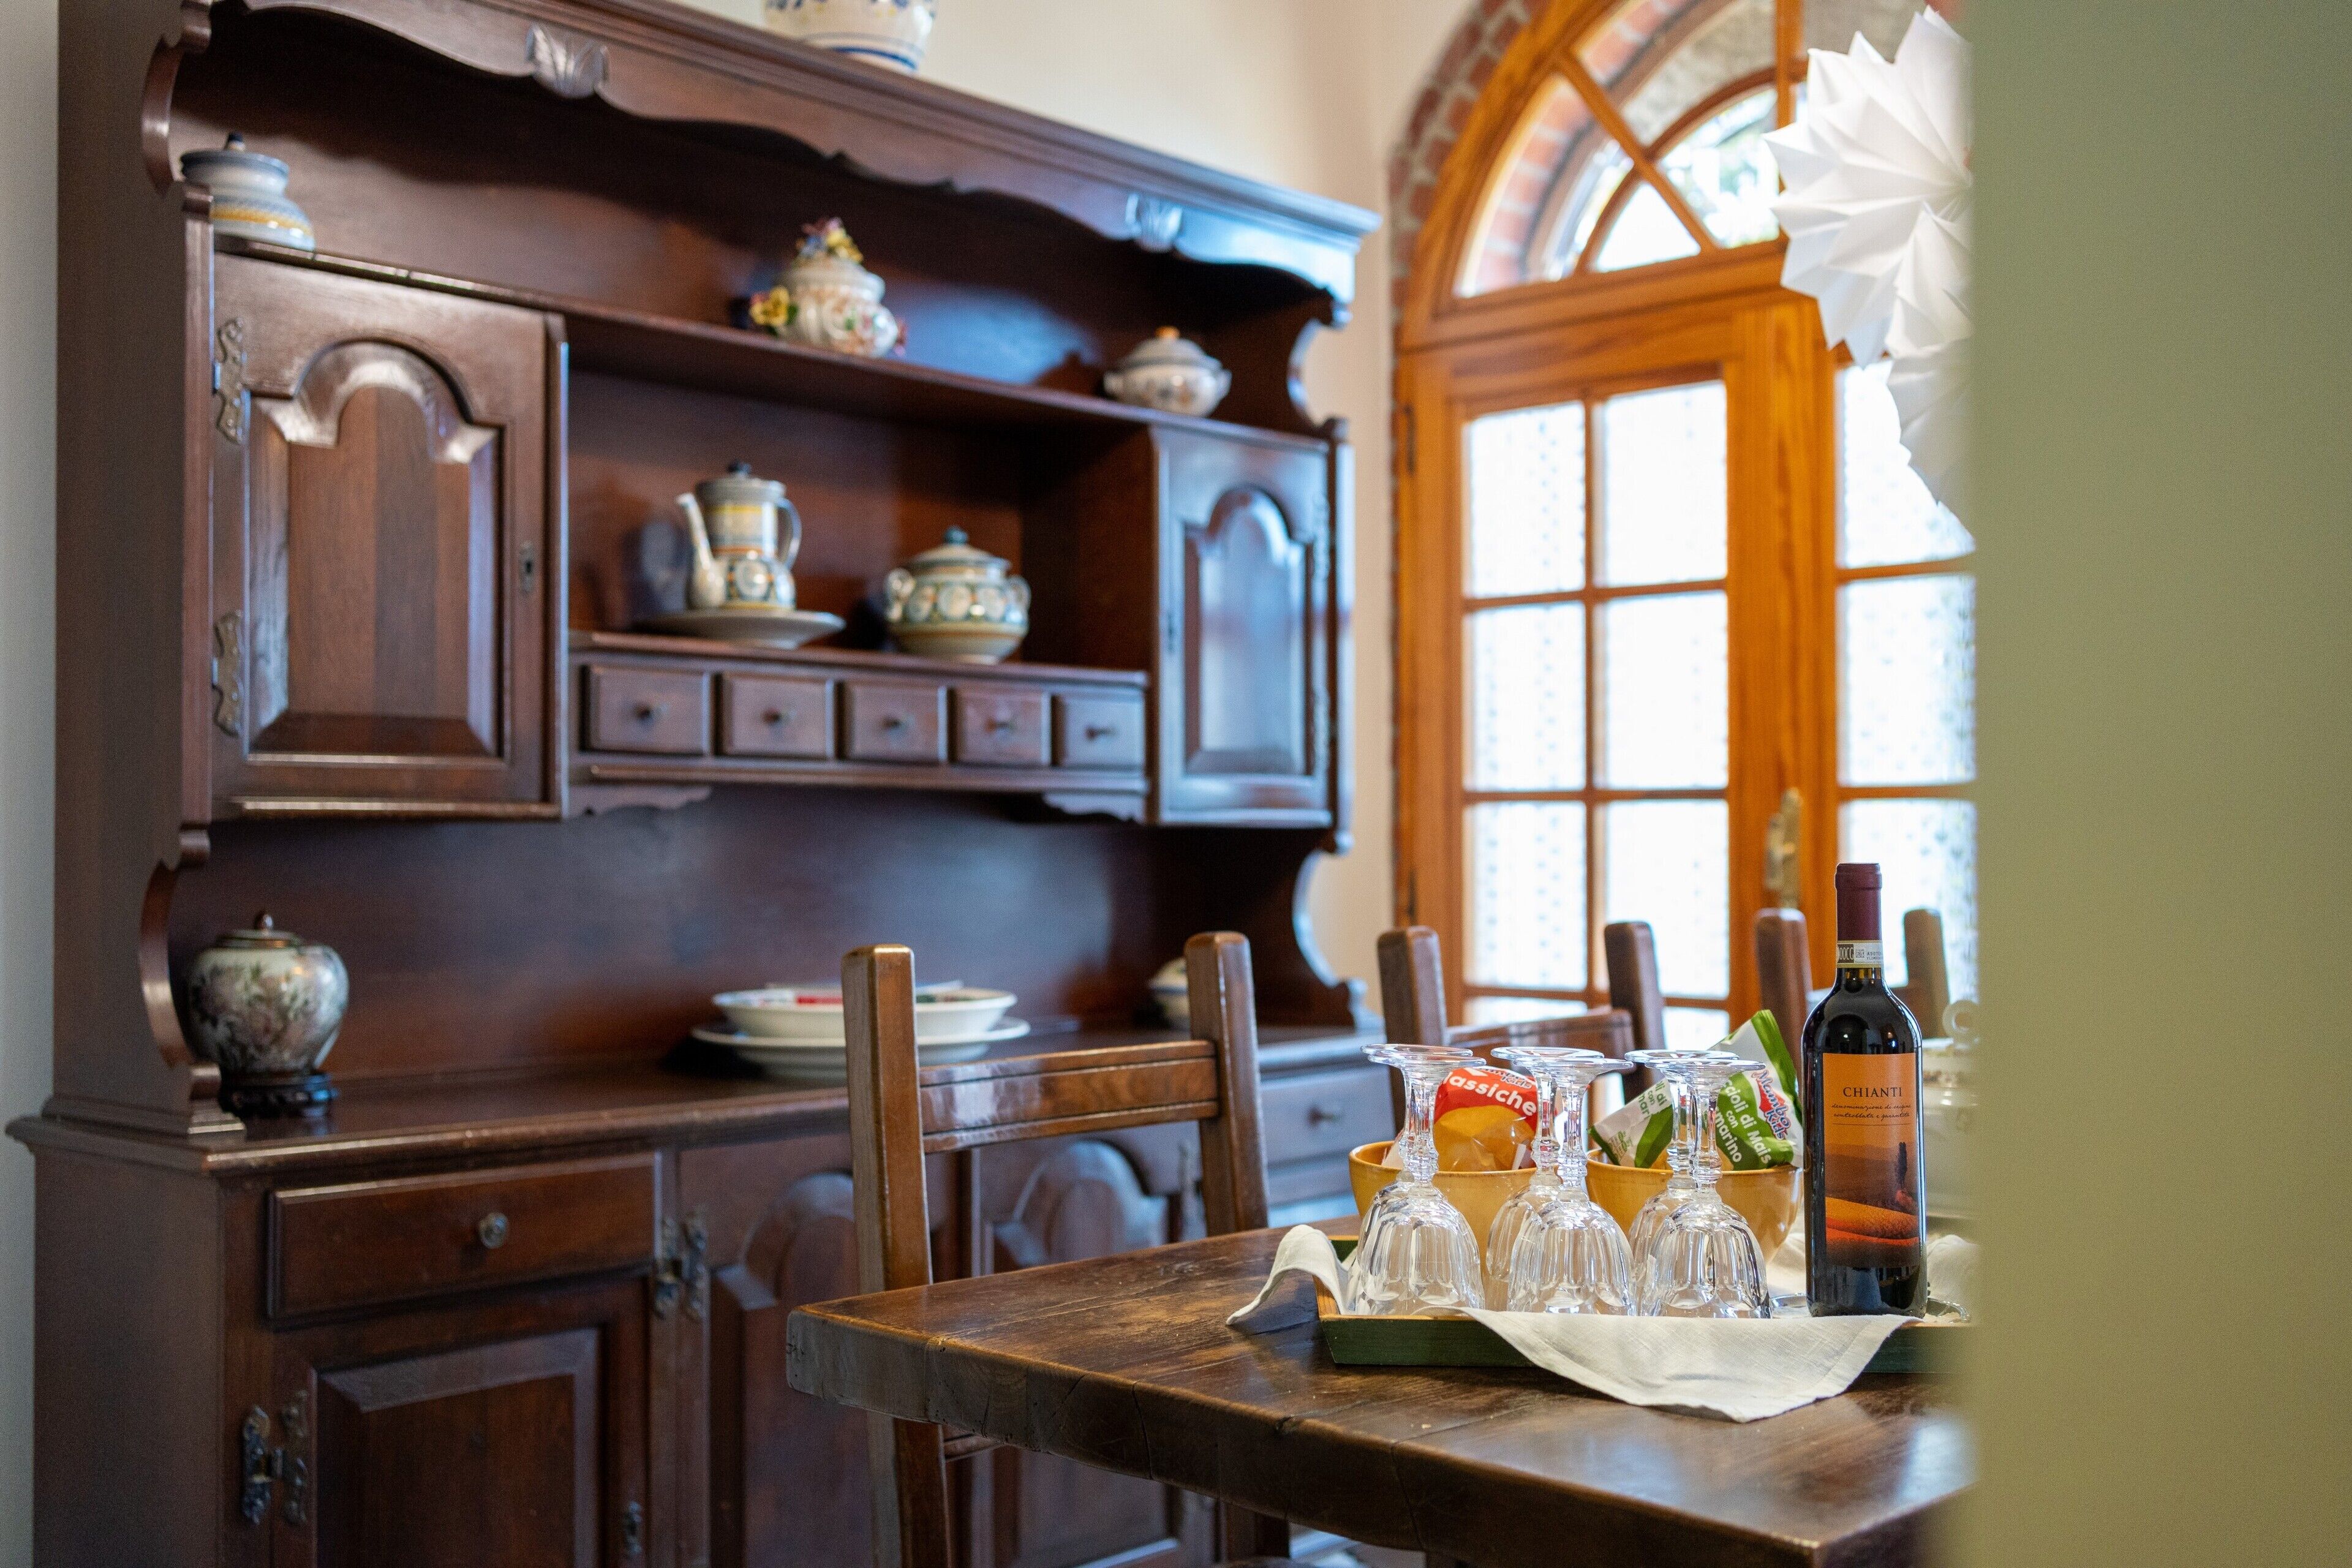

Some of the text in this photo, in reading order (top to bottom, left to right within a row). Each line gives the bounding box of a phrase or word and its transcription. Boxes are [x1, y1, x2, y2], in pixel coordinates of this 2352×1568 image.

[1647, 1090, 1657, 1106] con
[1656, 1093, 1667, 1107] di
[1751, 1070, 1792, 1129] Mambo
[1842, 1087, 1902, 1098] CHIANTI
[1831, 1103, 1883, 1112] denominazione
[1725, 1110, 1739, 1129] con
[1740, 1114, 1757, 1129] di
[1764, 1109, 1787, 1141] Kids
[1747, 1129, 1772, 1164] Mais
